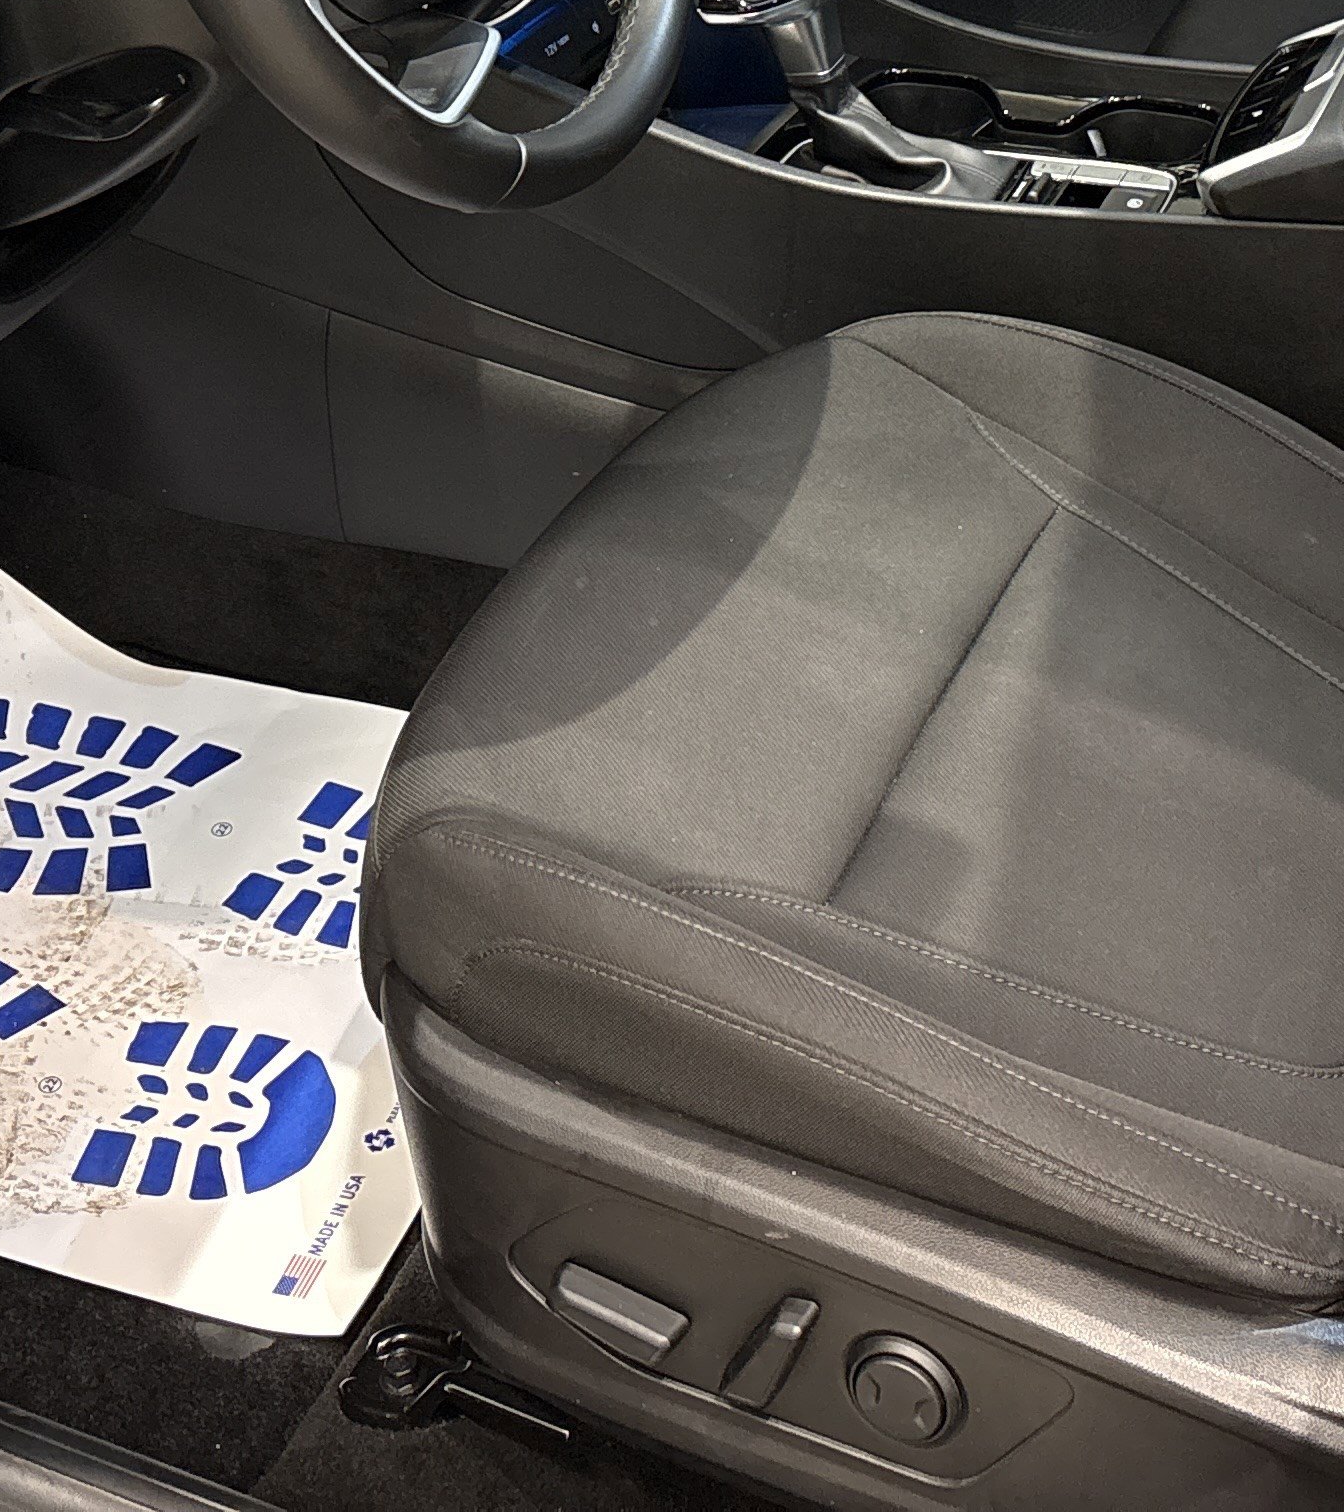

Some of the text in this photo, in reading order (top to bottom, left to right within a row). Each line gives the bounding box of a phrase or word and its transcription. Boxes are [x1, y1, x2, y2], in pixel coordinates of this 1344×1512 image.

[307, 1174, 367, 1257] MADE IN USA
